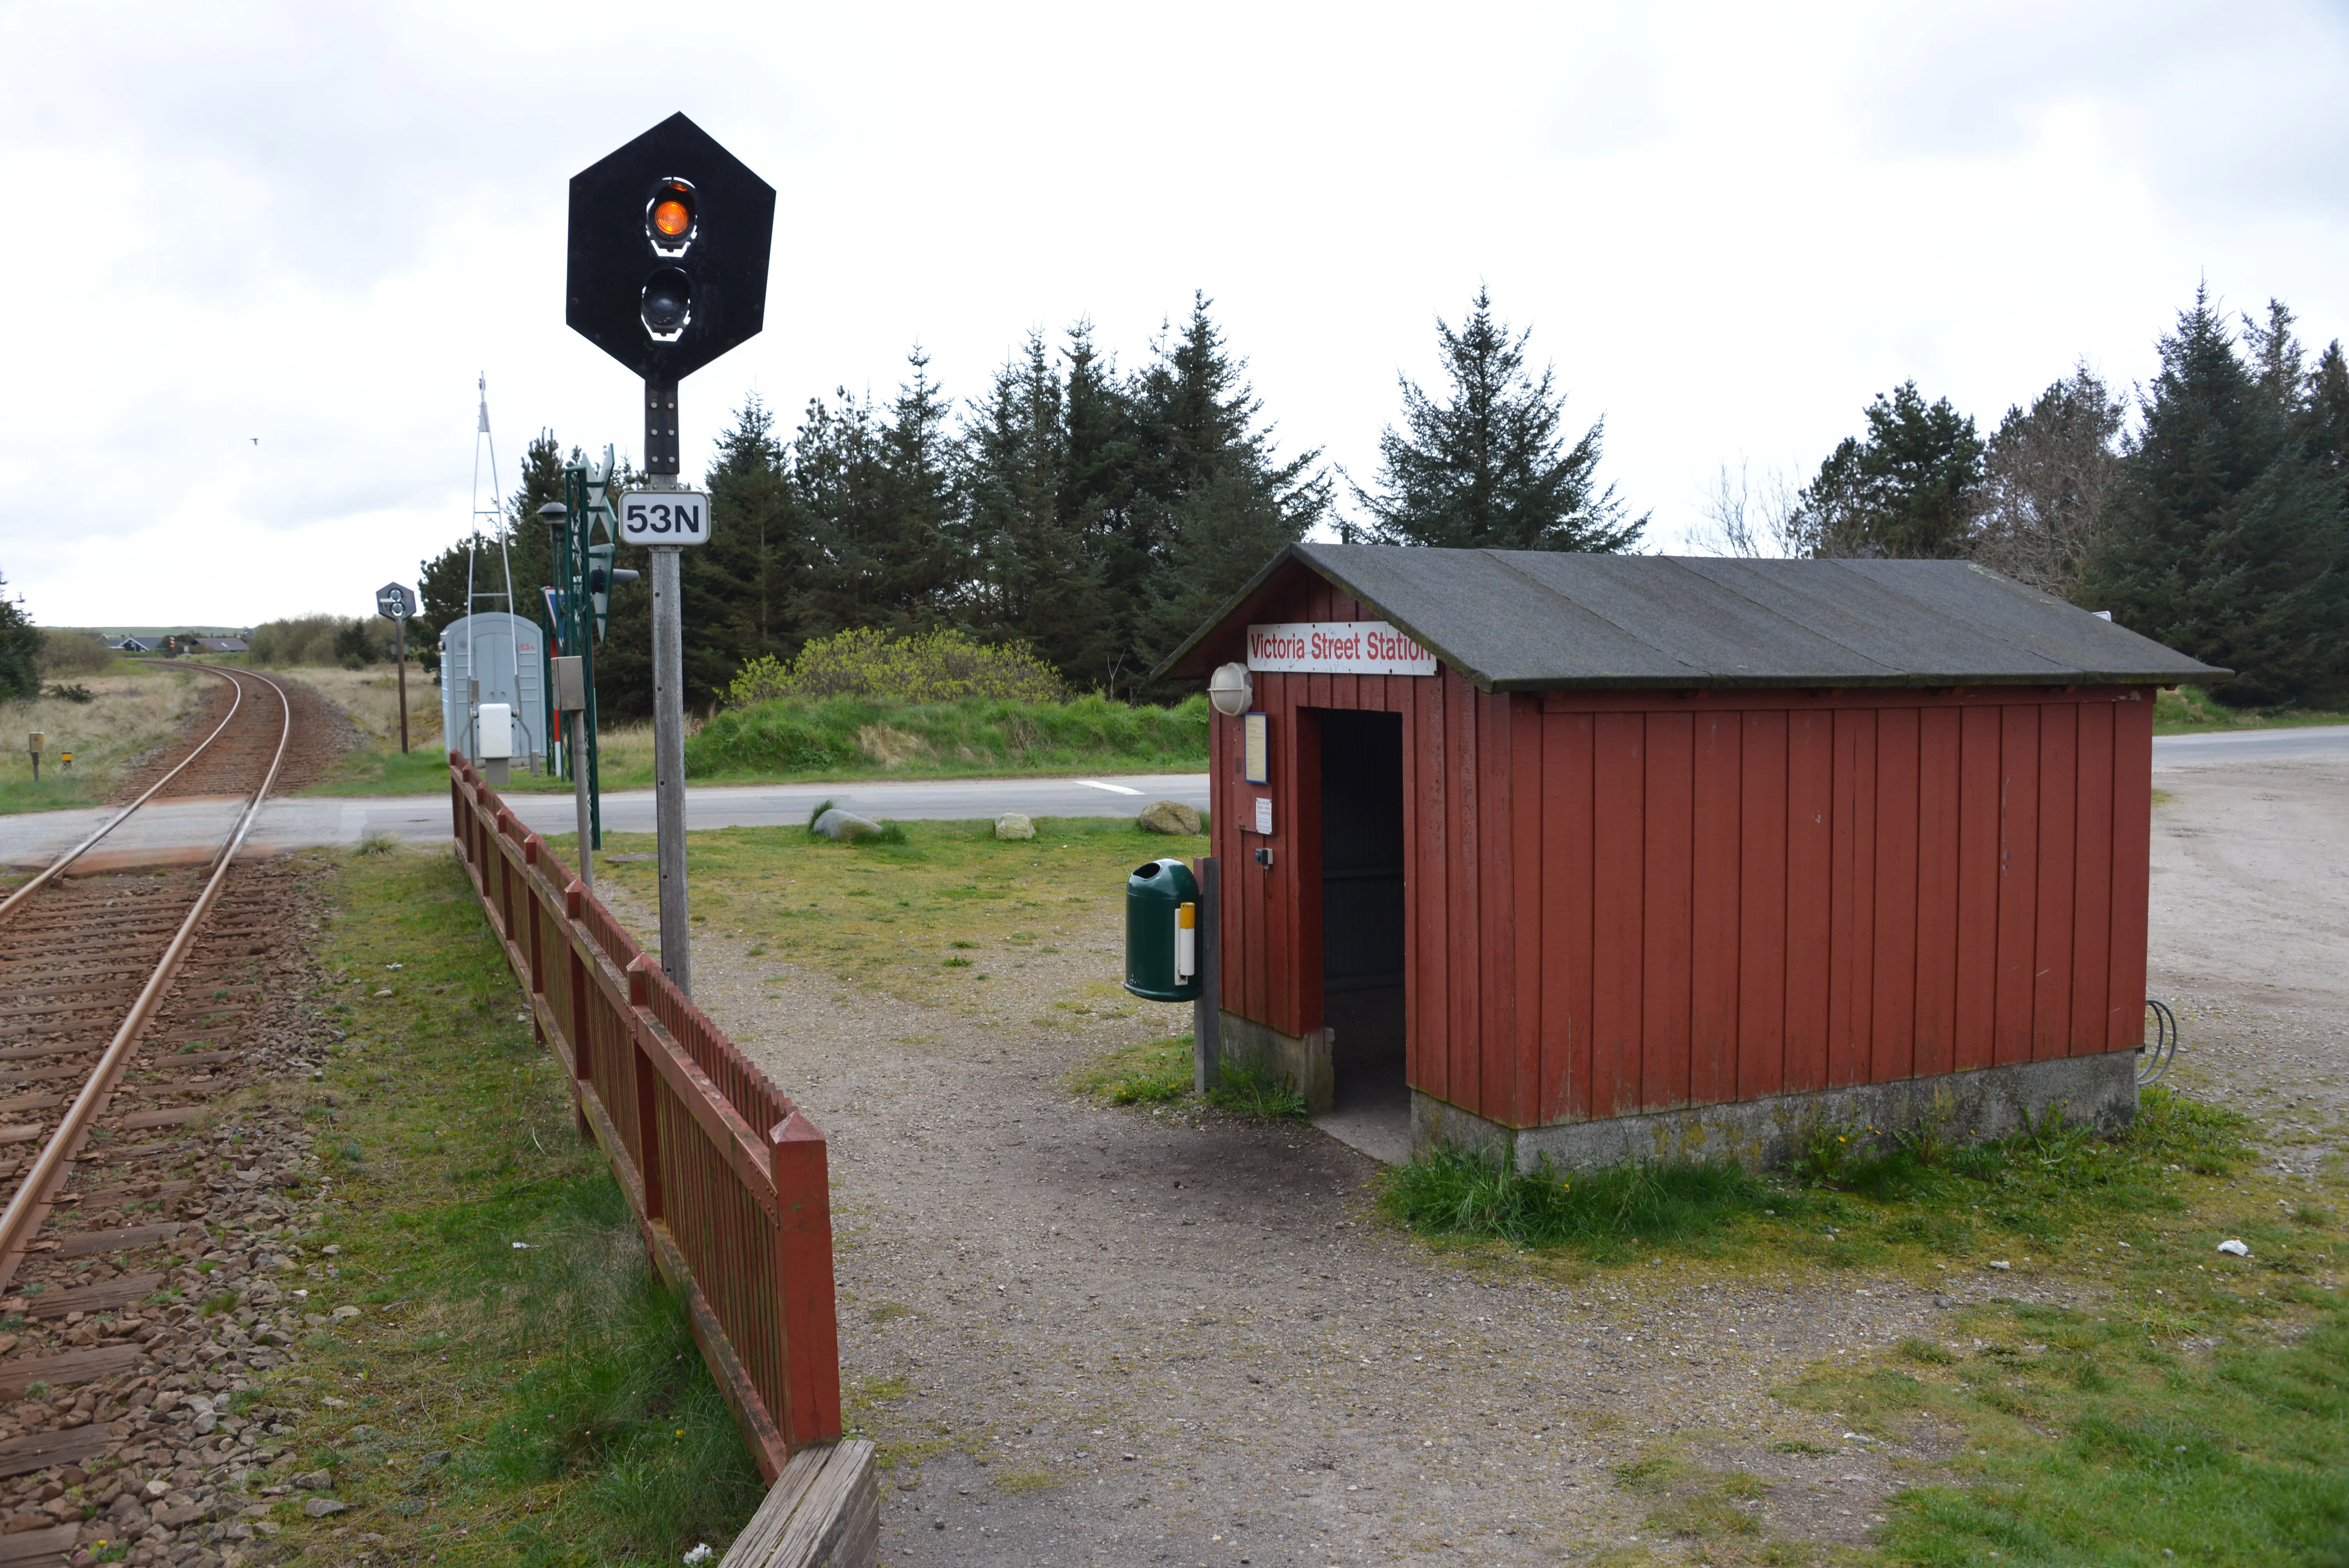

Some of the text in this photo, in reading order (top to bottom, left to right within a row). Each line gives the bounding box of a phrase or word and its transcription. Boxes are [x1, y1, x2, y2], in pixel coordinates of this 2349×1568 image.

[627, 504, 699, 533] 53N
[1251, 633, 1305, 659] Victoria
[1311, 632, 1360, 660] Street
